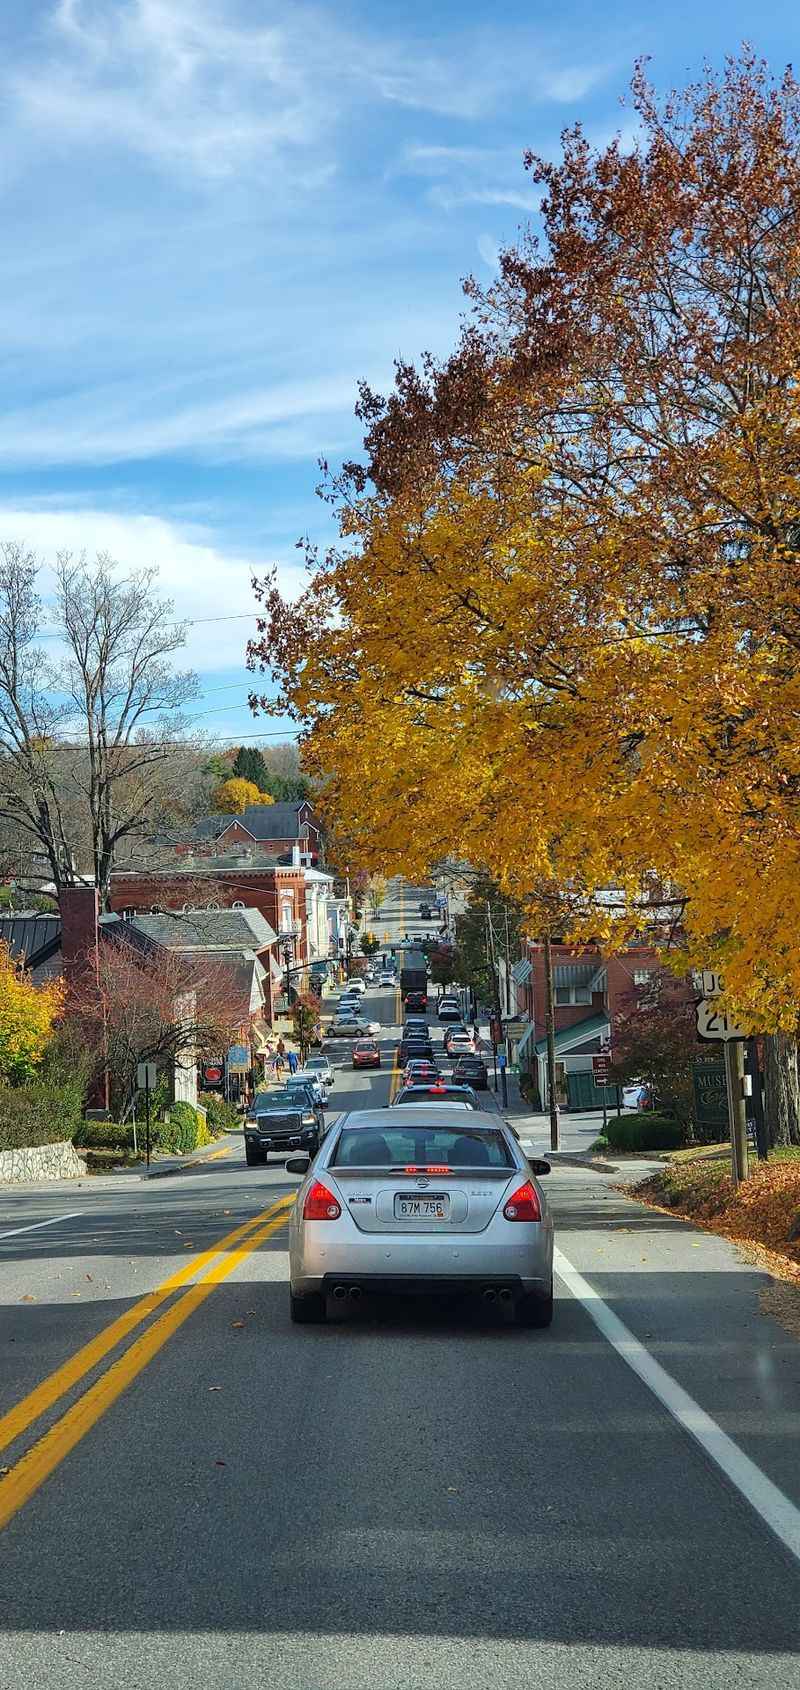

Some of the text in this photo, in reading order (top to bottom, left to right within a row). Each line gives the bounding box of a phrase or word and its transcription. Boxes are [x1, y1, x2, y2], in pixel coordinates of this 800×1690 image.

[699, 1075, 728, 1088] MUSE
[401, 1202, 442, 1213] 87M 756
